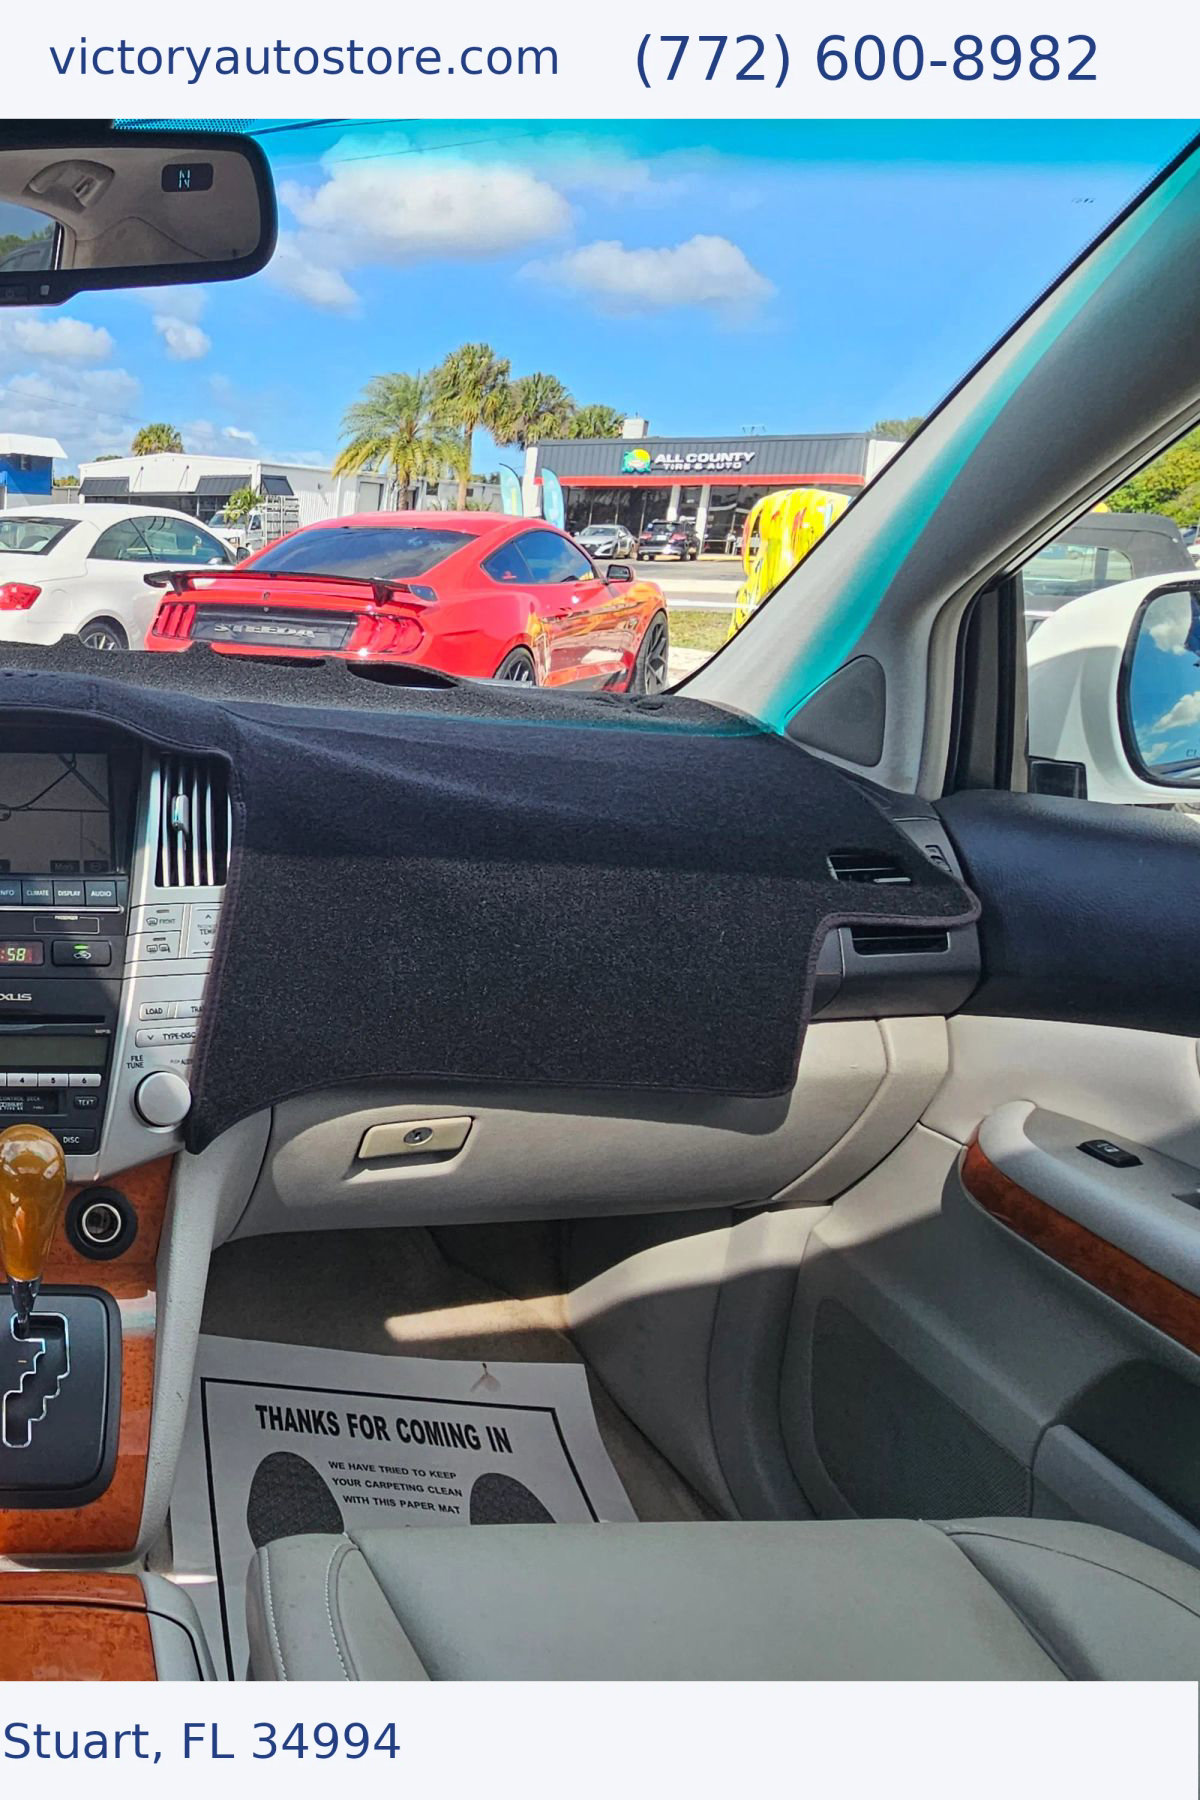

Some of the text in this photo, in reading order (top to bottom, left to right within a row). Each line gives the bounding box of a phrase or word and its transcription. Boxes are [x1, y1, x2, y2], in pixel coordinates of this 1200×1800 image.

[178, 169, 191, 189] N
[655, 454, 684, 464] ALL
[686, 452, 755, 463] COUNTY
[145, 1007, 163, 1015] LOAD
[62, 1136, 80, 1144] DISC
[254, 1404, 513, 1454] THANKS FOR COMING IN
[328, 1460, 457, 1481] WE HAVE TRIED TO KEEP
[332, 1477, 463, 1498] YOUR CARPETING CLEAN
[343, 1494, 461, 1515] WITH THIS PAPER MAT
